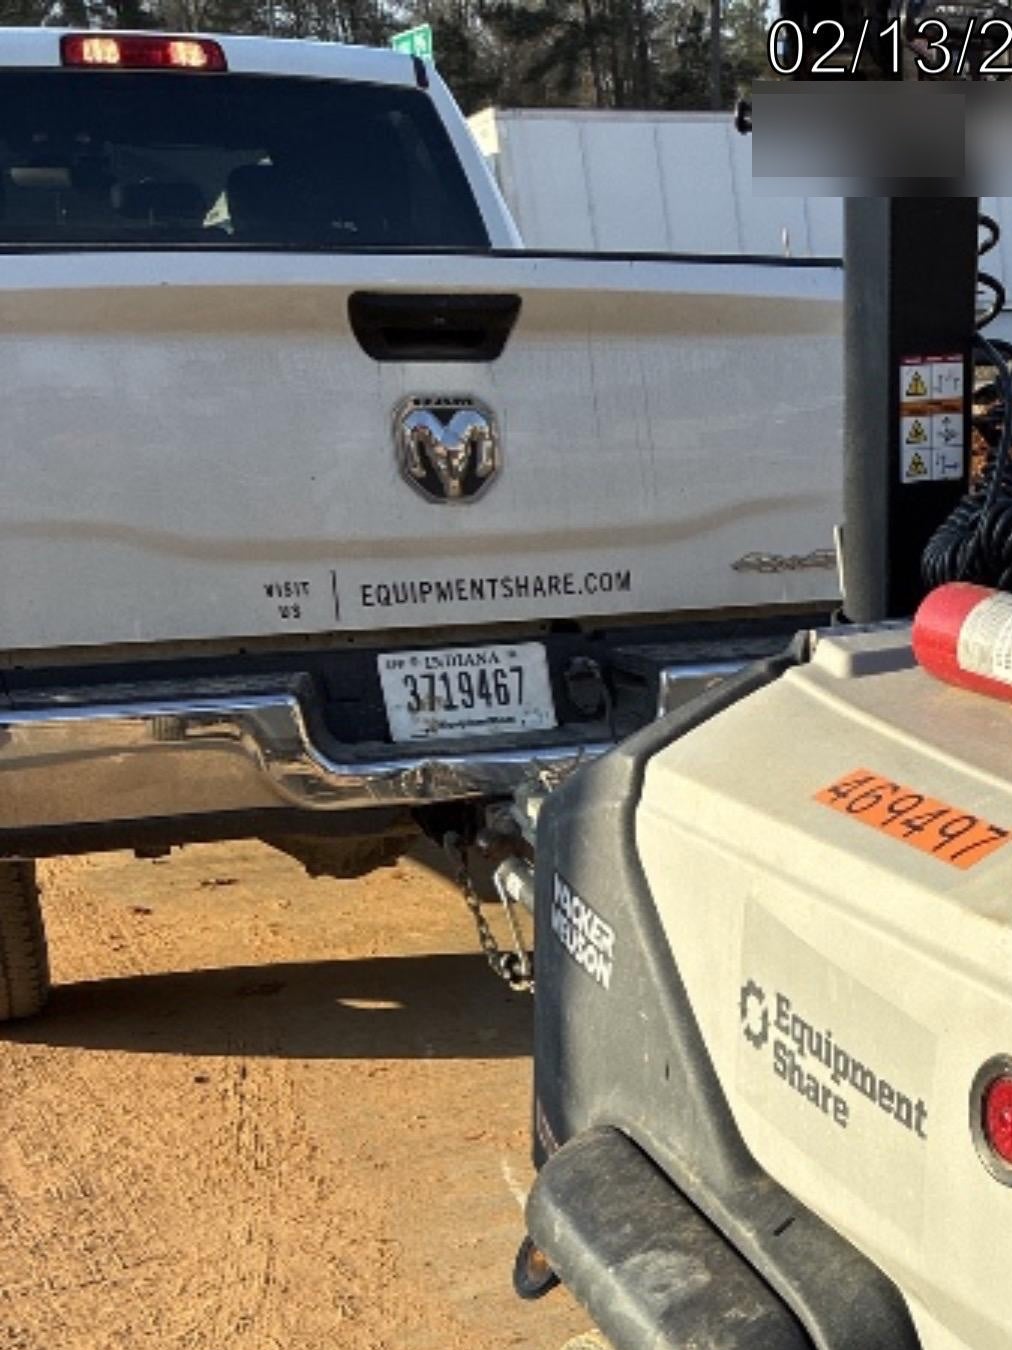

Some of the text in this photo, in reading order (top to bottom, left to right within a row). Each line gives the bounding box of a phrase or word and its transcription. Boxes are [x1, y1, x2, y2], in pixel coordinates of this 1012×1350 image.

[361, 570, 632, 608] EQUIPMENTSHARE.COM
[402, 665, 524, 713] 3719467
[424, 651, 501, 670] INDIANA
[827, 775, 1011, 862] 469497
[772, 1037, 850, 1129] Share
[774, 991, 928, 1140] Equipment
